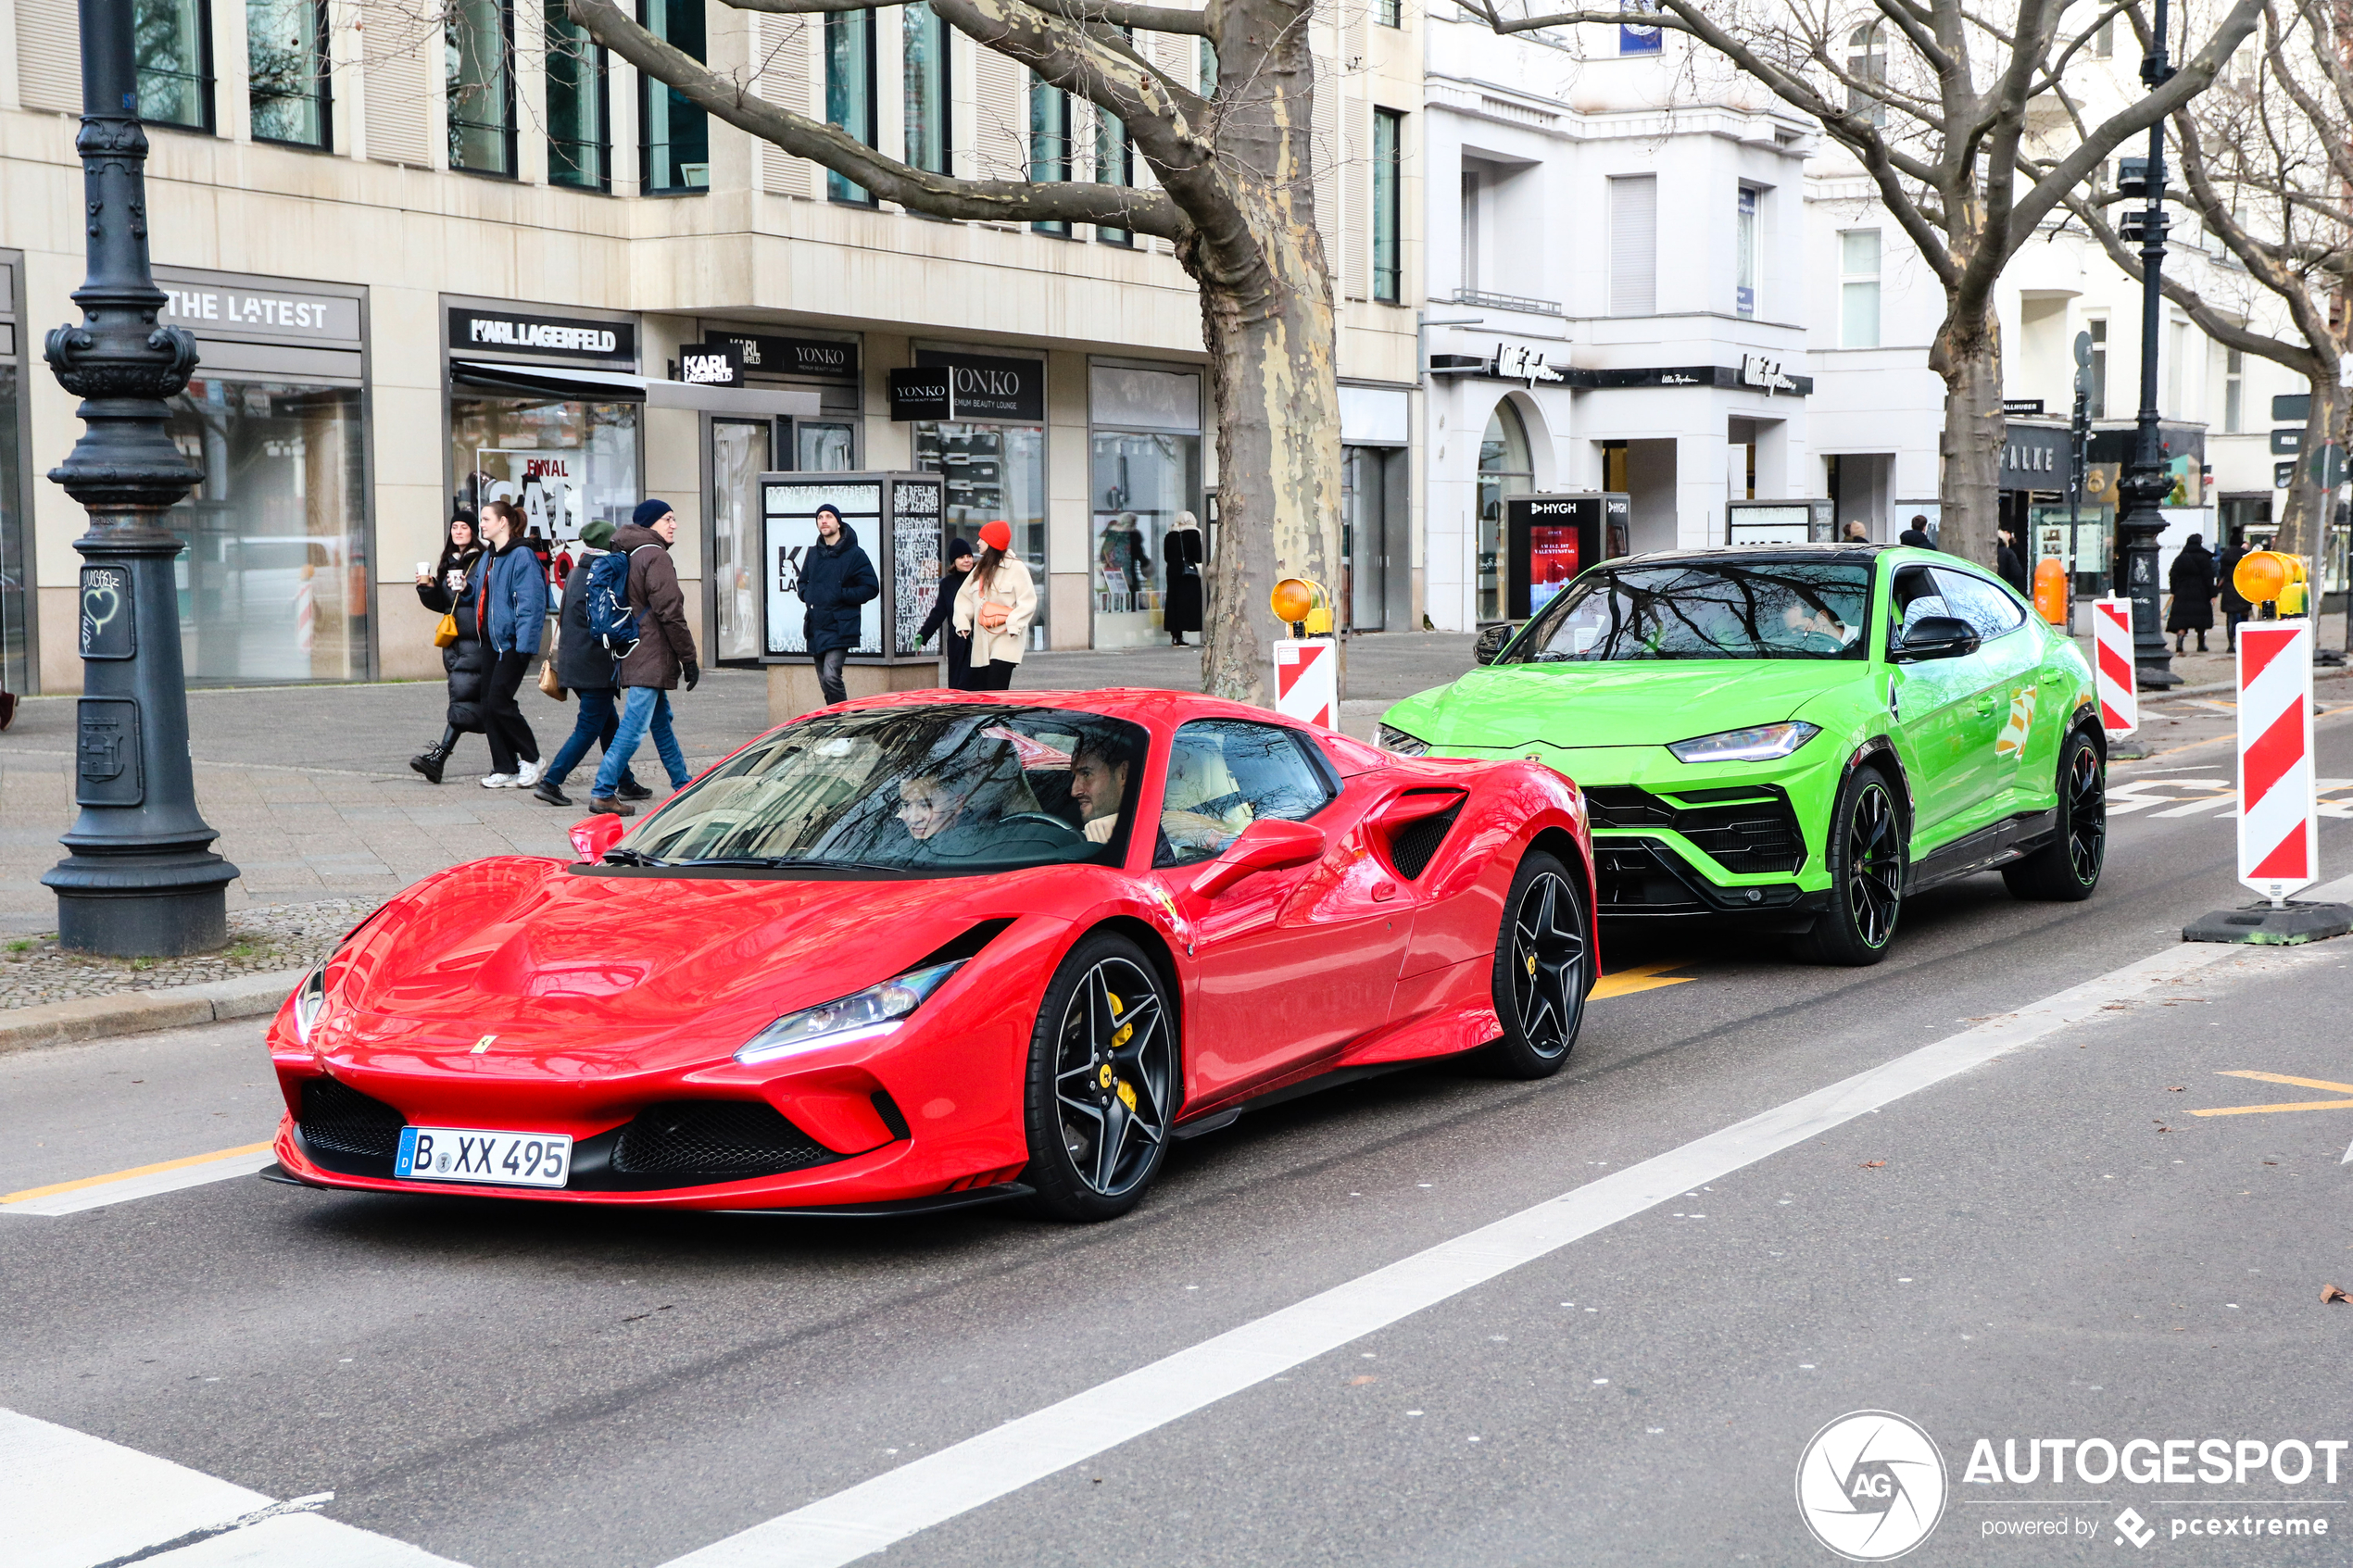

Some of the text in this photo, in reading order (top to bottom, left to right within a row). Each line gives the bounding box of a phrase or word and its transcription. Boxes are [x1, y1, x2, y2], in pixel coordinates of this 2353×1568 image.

[164, 290, 327, 328] THE LATEST
[472, 319, 617, 353] KARL LAGERFELD
[796, 346, 844, 364] YONKO
[683, 354, 733, 374] KARL
[684, 372, 734, 383] LAGERFELD
[897, 385, 945, 397] YONKO
[954, 398, 1017, 410] EMIUM BEAUTY LOUNGE
[526, 459, 569, 477] FINAL
[1543, 503, 1577, 514] HYGH
[1613, 502, 1627, 513] HYGH
[401, 1157, 409, 1168] D
[414, 1135, 565, 1179] B XX 495
